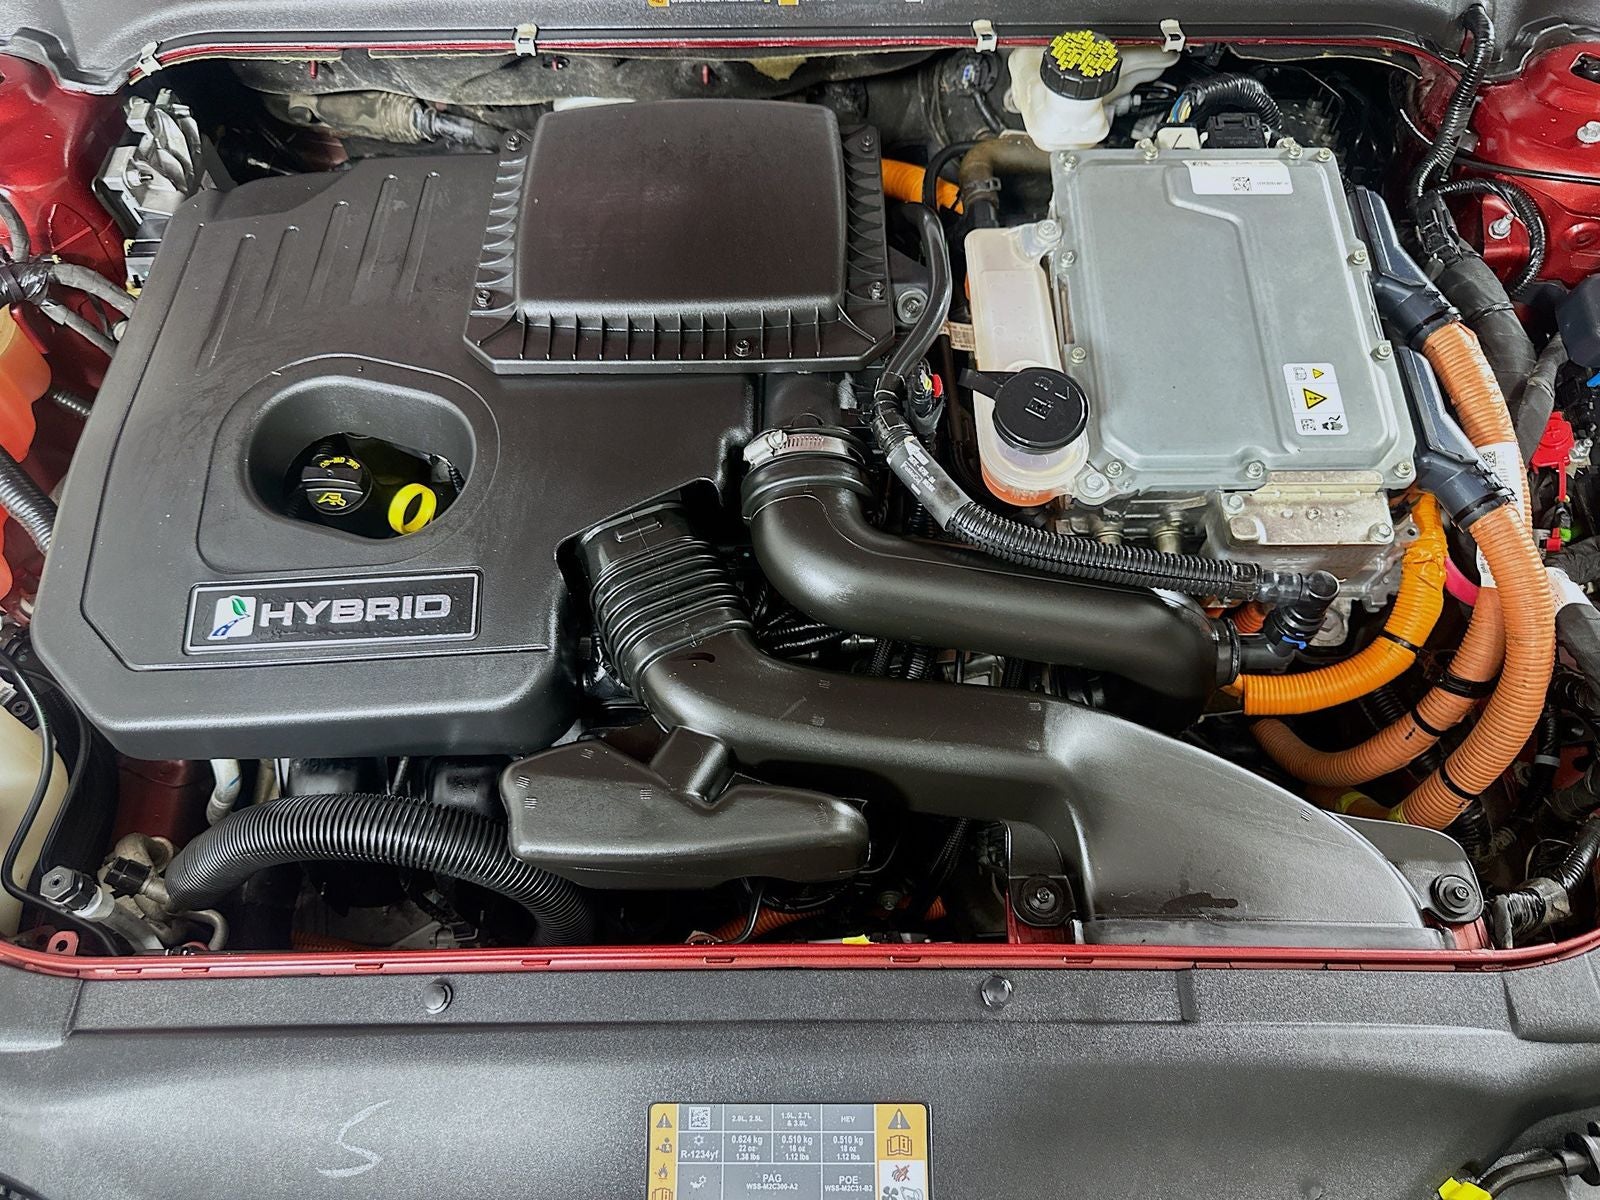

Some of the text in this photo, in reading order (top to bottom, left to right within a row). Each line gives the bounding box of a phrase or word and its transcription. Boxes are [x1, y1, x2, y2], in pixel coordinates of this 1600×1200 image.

[346, 458, 361, 470] SAE
[260, 594, 451, 627] HYBRID
[840, 1115, 856, 1123] HEV
[731, 1134, 764, 1146] 0.624 kg
[781, 1134, 813, 1146] 0.510 kg
[833, 1135, 864, 1146] 0.510 kg
[680, 1149, 719, 1161] R-1234yf
[750, 1152, 760, 1160] lbs
[762, 1173, 782, 1183] PAG
[838, 1175, 859, 1185] POE
